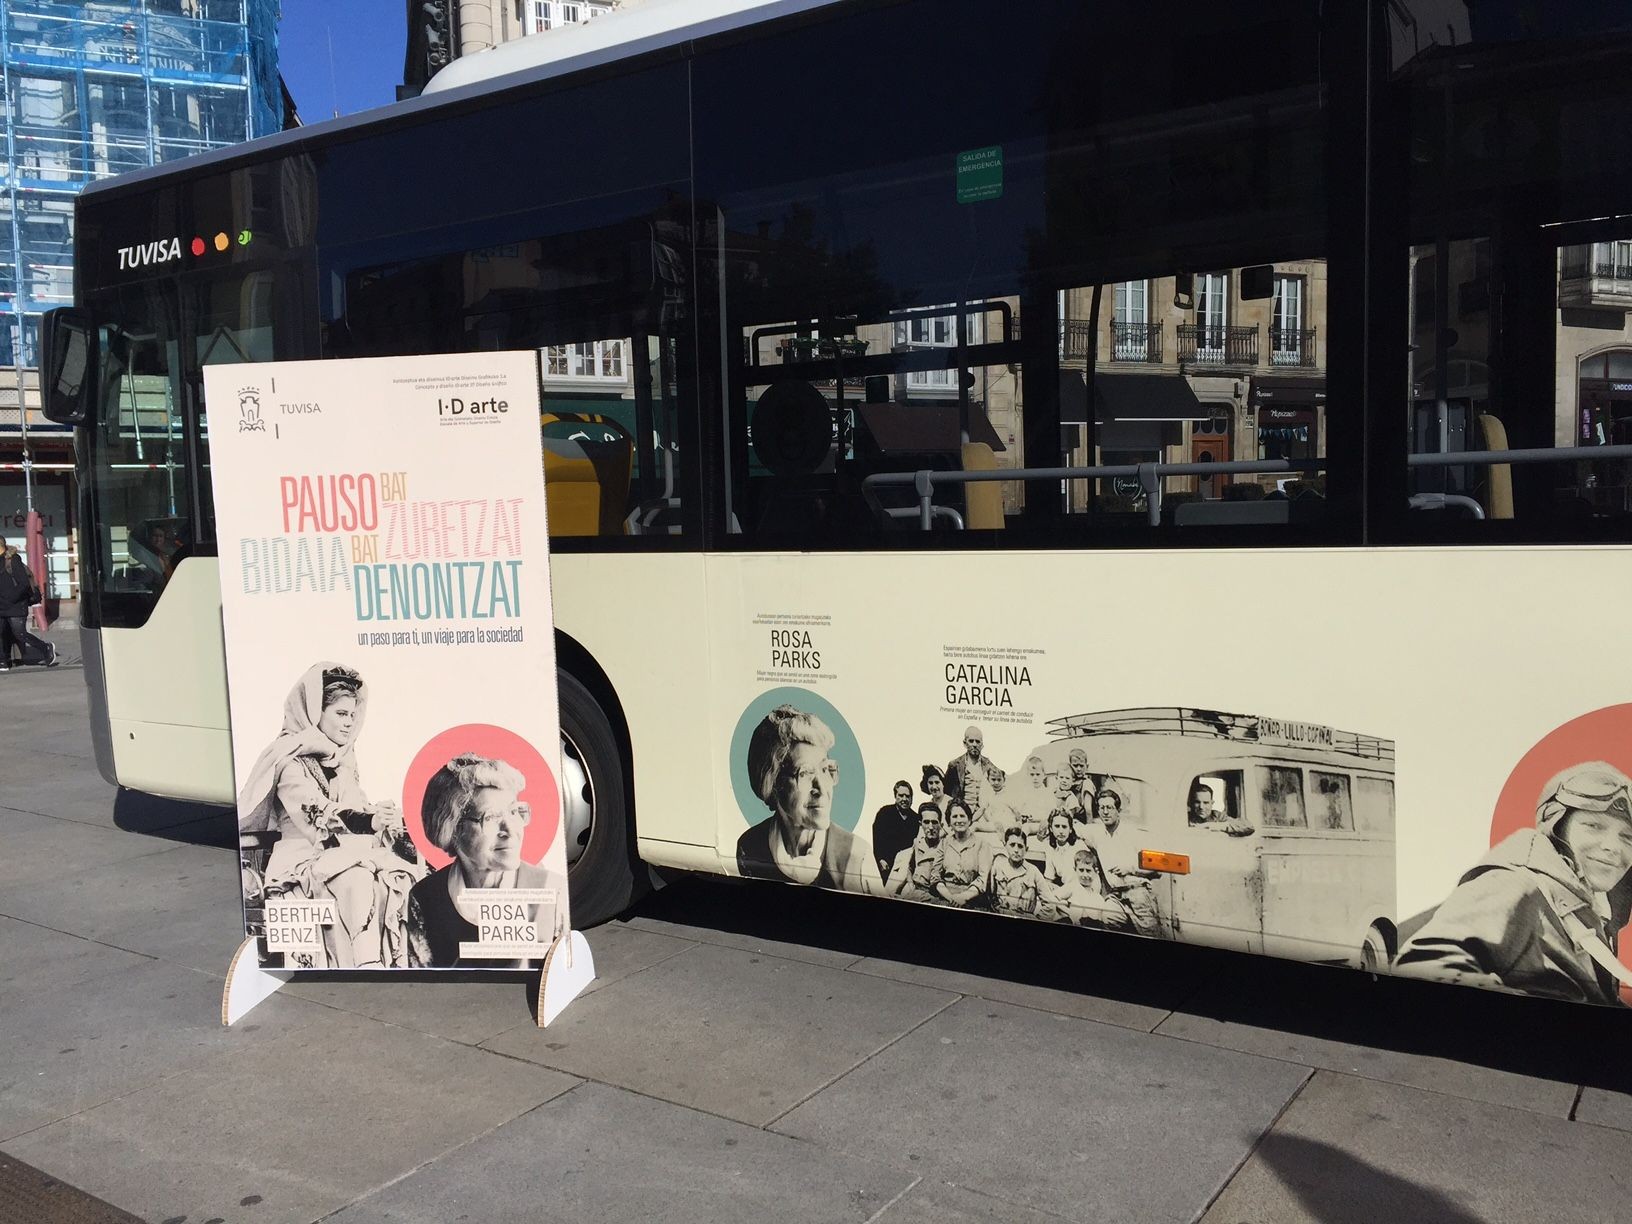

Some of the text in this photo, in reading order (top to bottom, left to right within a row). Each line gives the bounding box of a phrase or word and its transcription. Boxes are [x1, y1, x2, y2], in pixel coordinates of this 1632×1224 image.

[962, 152, 986, 162] SALIDA
[958, 160, 1001, 173] EMERGENCIA
[118, 237, 182, 270] TUVISA
[280, 403, 322, 414] TUVISA
[470, 397, 509, 414] arte
[280, 472, 408, 533] PAUSO BAT
[382, 498, 524, 560] ZURETZAT
[240, 534, 378, 594] BIDAIA BAT
[354, 560, 523, 621] DENONTZAT
[358, 626, 524, 647] un paso para ti, un viaje para la sociedad
[771, 630, 813, 648] ROSA
[772, 650, 820, 669] PARKS
[945, 663, 1032, 686] CATALINA
[946, 685, 1013, 708] GARCIA
[268, 907, 334, 922] BERTHA
[480, 904, 526, 920] ROSA
[270, 928, 313, 943] BENZ
[482, 926, 535, 941] PARKS
